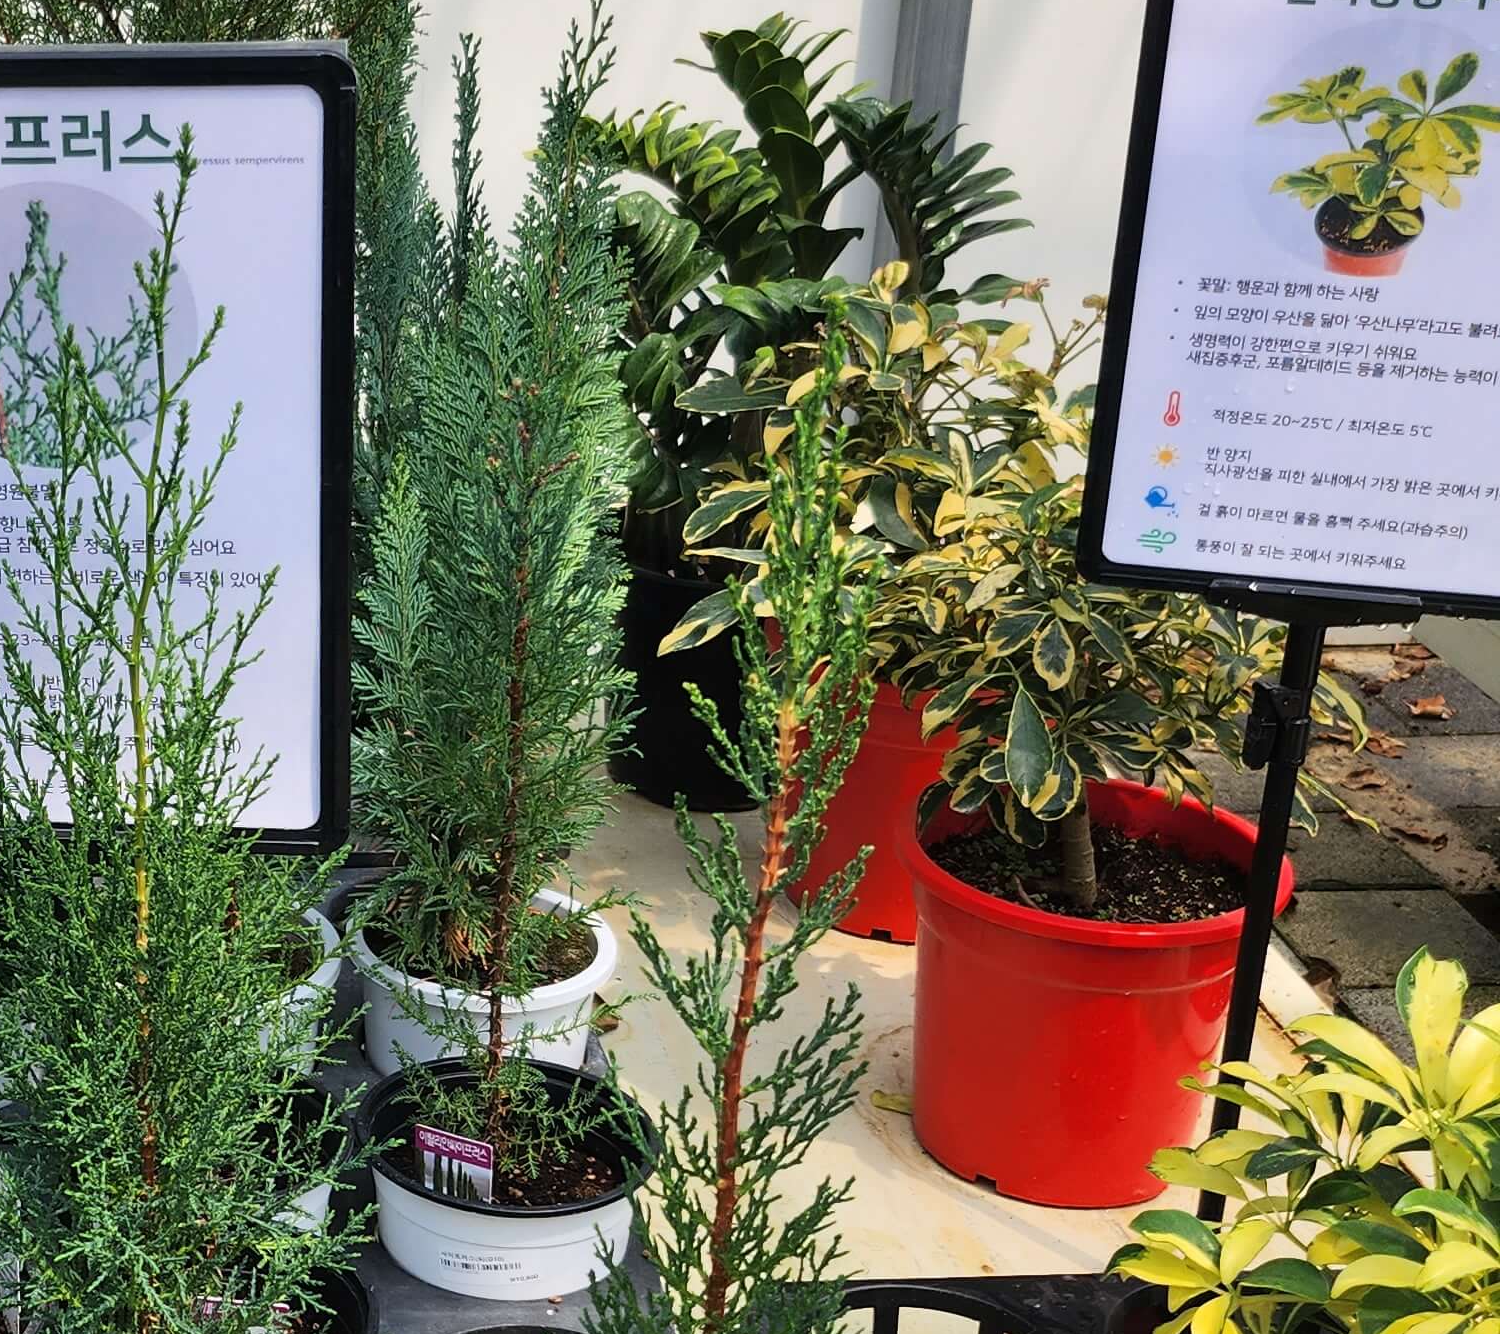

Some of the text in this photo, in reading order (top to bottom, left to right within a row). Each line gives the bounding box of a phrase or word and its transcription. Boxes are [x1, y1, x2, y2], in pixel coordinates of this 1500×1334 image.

[235, 152, 305, 167] sempervirens
[1197, 277, 1231, 294] 꽃말:
[1236, 279, 1280, 297] 행운과
[1283, 281, 1313, 299] 함께
[1316, 283, 1346, 301] 하는
[1194, 304, 1222, 321] 잎의
[1225, 307, 1269, 324] 모양이
[1271, 310, 1316, 328] 우산을
[1320, 312, 1350, 329] 닮아
[1467, 321, 1500, 339] 불려
[1188, 331, 1418, 362] 생명력이 강한편으로 키우기 쉬워요
[1185, 350, 1499, 387] 새집증후군, 포름알데히드 등을 제거하는 능력이
[1212, 408, 1267, 426] 적정온도
[1335, 418, 1345, 433] /
[1348, 418, 1405, 436] 최저온도
[1206, 445, 1253, 464] 반 양지
[1204, 462, 1273, 483] 직사광선을
[1276, 468, 1305, 486] 피한
[1309, 471, 1367, 491] 실내에서
[1370, 476, 1400, 494] 가장
[1403, 477, 1432, 496] 밝은
[1436, 482, 1481, 500] 곳에서
[1215, 504, 1242, 521] 흙이
[1246, 506, 1289, 524] 마르면
[1293, 510, 1320, 527] 물을
[1356, 516, 1469, 541] 주세요(과습주의)
[188, 539, 237, 556] 심어요
[1195, 538, 1407, 571] 통풍이 잘 되는 곳에서 키워주세요
